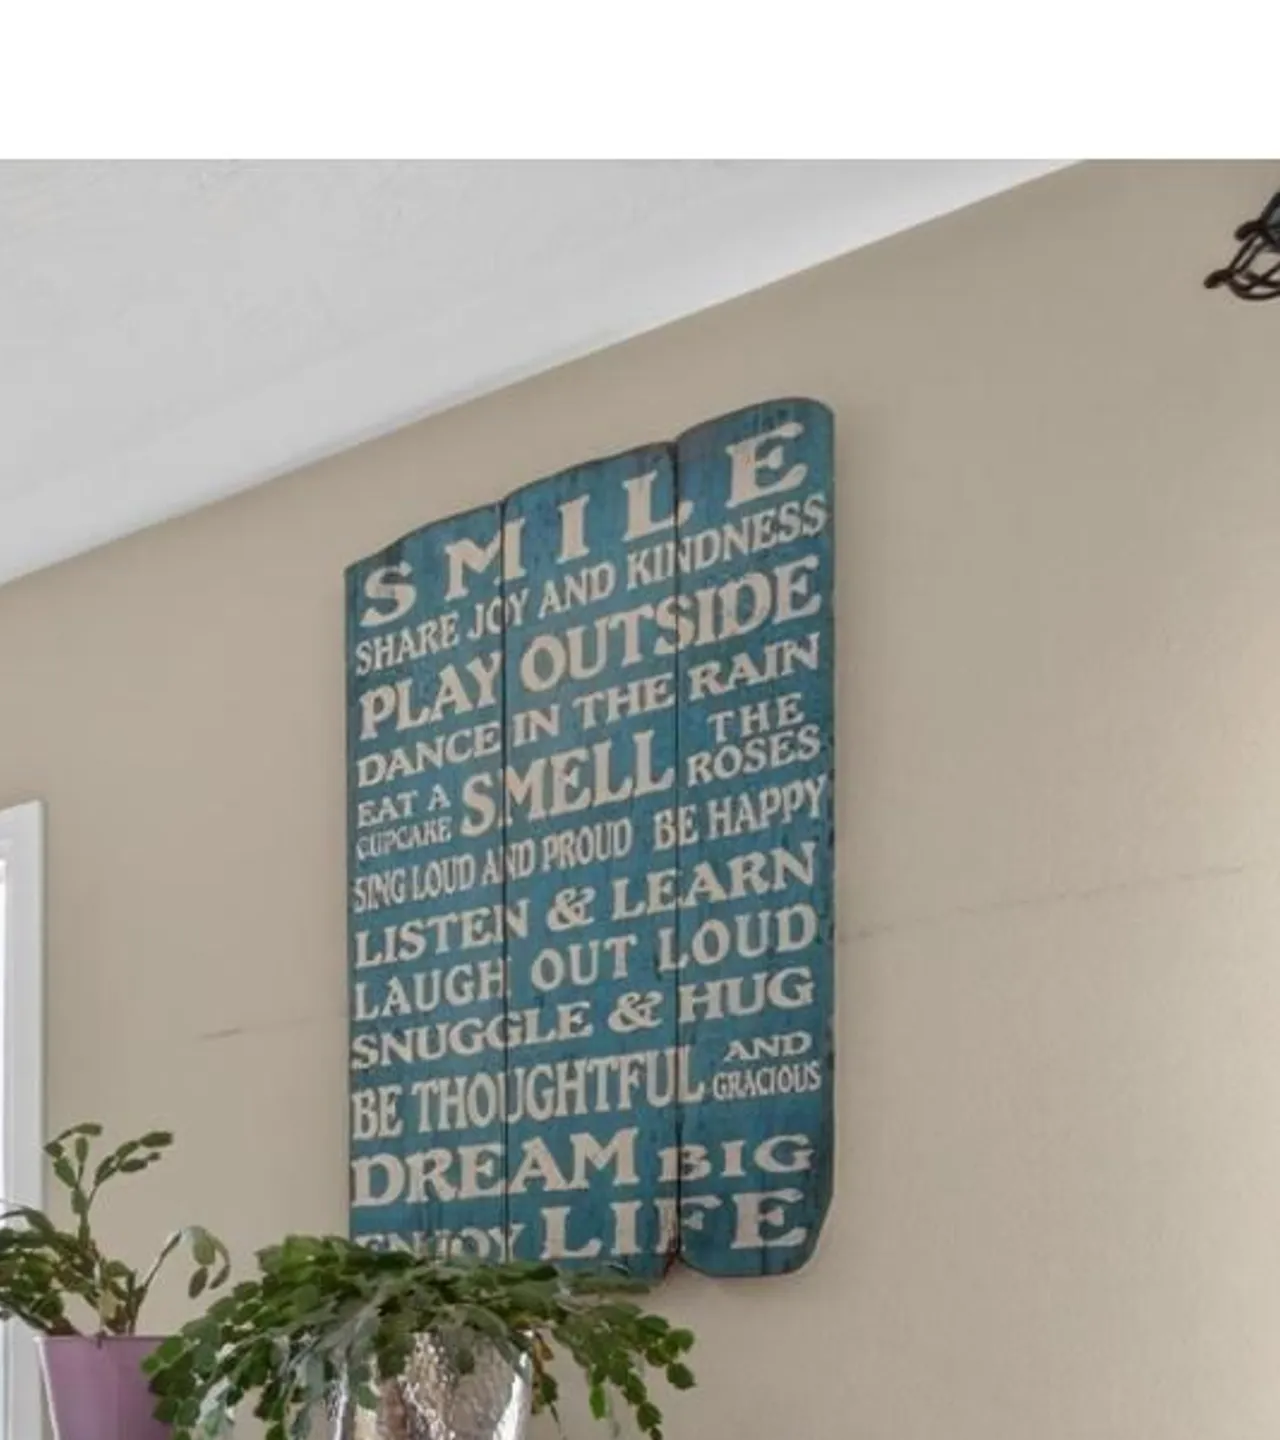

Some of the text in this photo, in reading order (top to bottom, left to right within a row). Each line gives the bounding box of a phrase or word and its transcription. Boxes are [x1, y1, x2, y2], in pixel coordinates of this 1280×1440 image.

[360, 422, 808, 627] SMILE
[355, 495, 828, 675] SHARE JOY AND KINDNESS
[359, 555, 821, 740] PLAY OUTSIDE
[356, 633, 820, 788] DANCE IN THE RAIN
[687, 724, 820, 787] ROSES
[707, 693, 805, 743] THE
[358, 783, 451, 828] EAT A
[460, 729, 674, 836] SMELL
[354, 774, 827, 913] SING LOUD AND PROUD BE HAPPY
[356, 817, 452, 860] CUPCAKE
[355, 842, 817, 969] LISTEN & LEARN
[354, 903, 818, 1022] LAUGH OUT LOUD
[351, 967, 816, 1070] SNUGGLE & HUG
[723, 1031, 812, 1062] AND
[352, 1045, 705, 1140] BE THOUGHTFUL
[712, 1060, 821, 1101] GRACIOUS
[351, 1127, 813, 1208] DREAM BIG
[541, 1188, 807, 1260] LIFE
